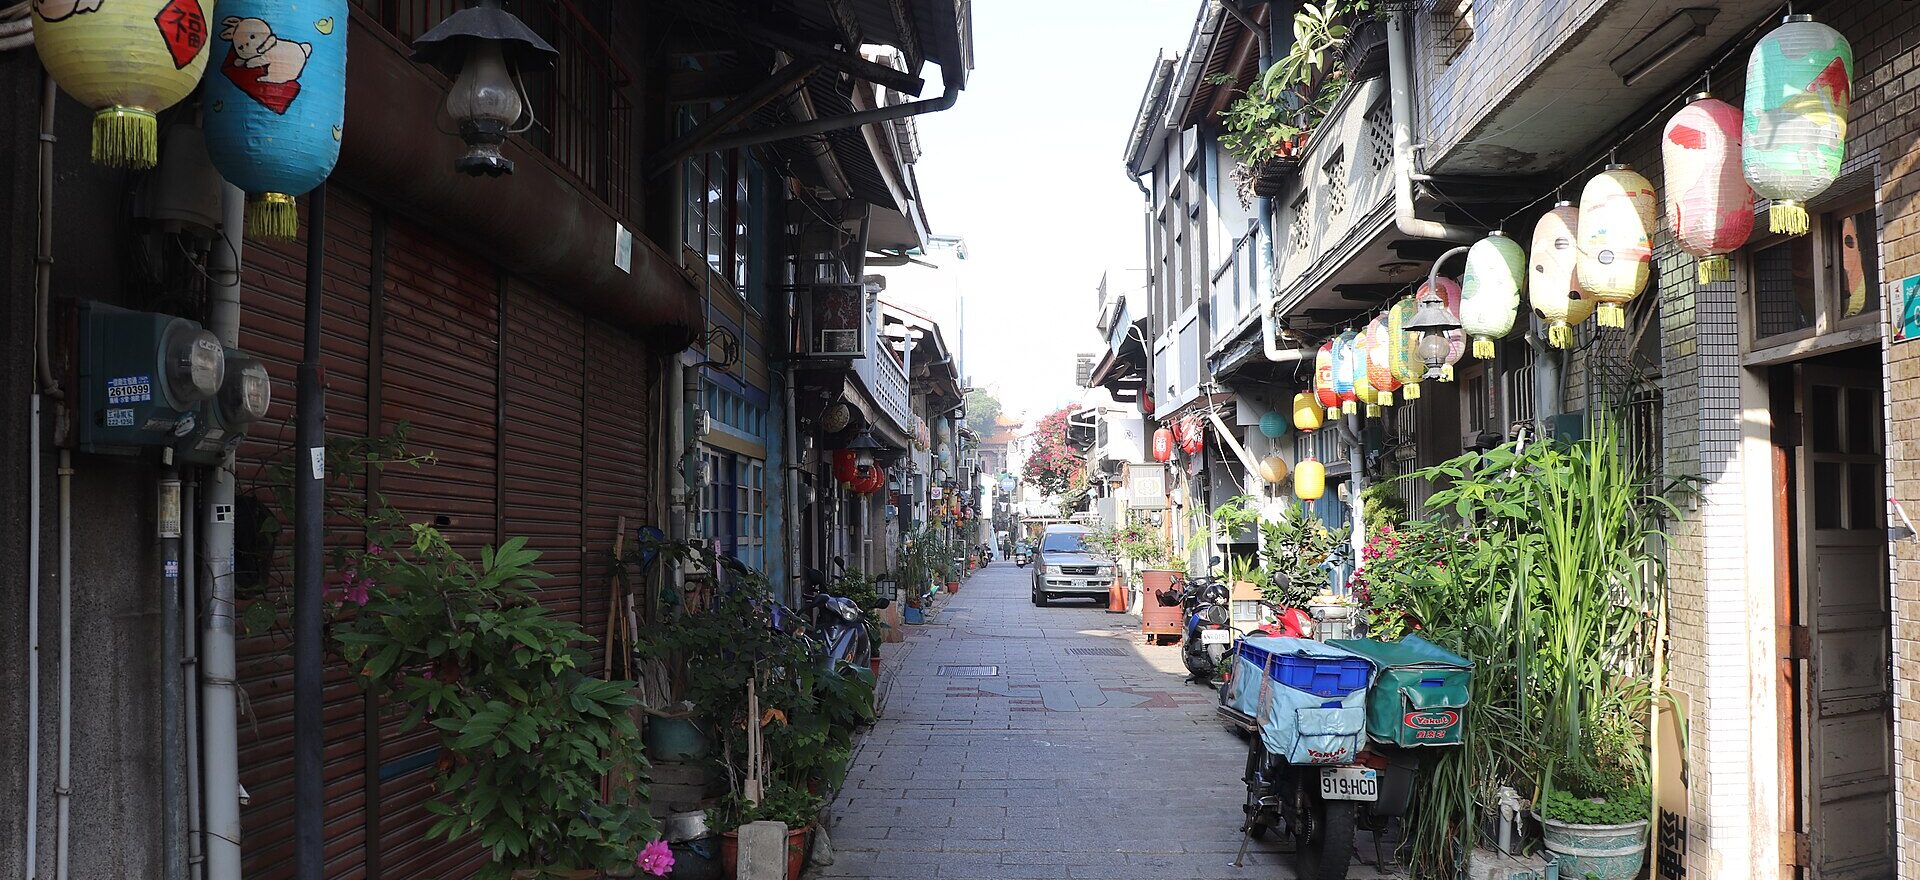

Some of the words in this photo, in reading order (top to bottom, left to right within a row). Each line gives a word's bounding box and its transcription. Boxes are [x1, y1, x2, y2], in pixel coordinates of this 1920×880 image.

[167, 5, 202, 49] 福
[109, 384, 149, 396] 2610399
[1416, 715, 1449, 724] Yakult
[1307, 747, 1347, 758] Yakult
